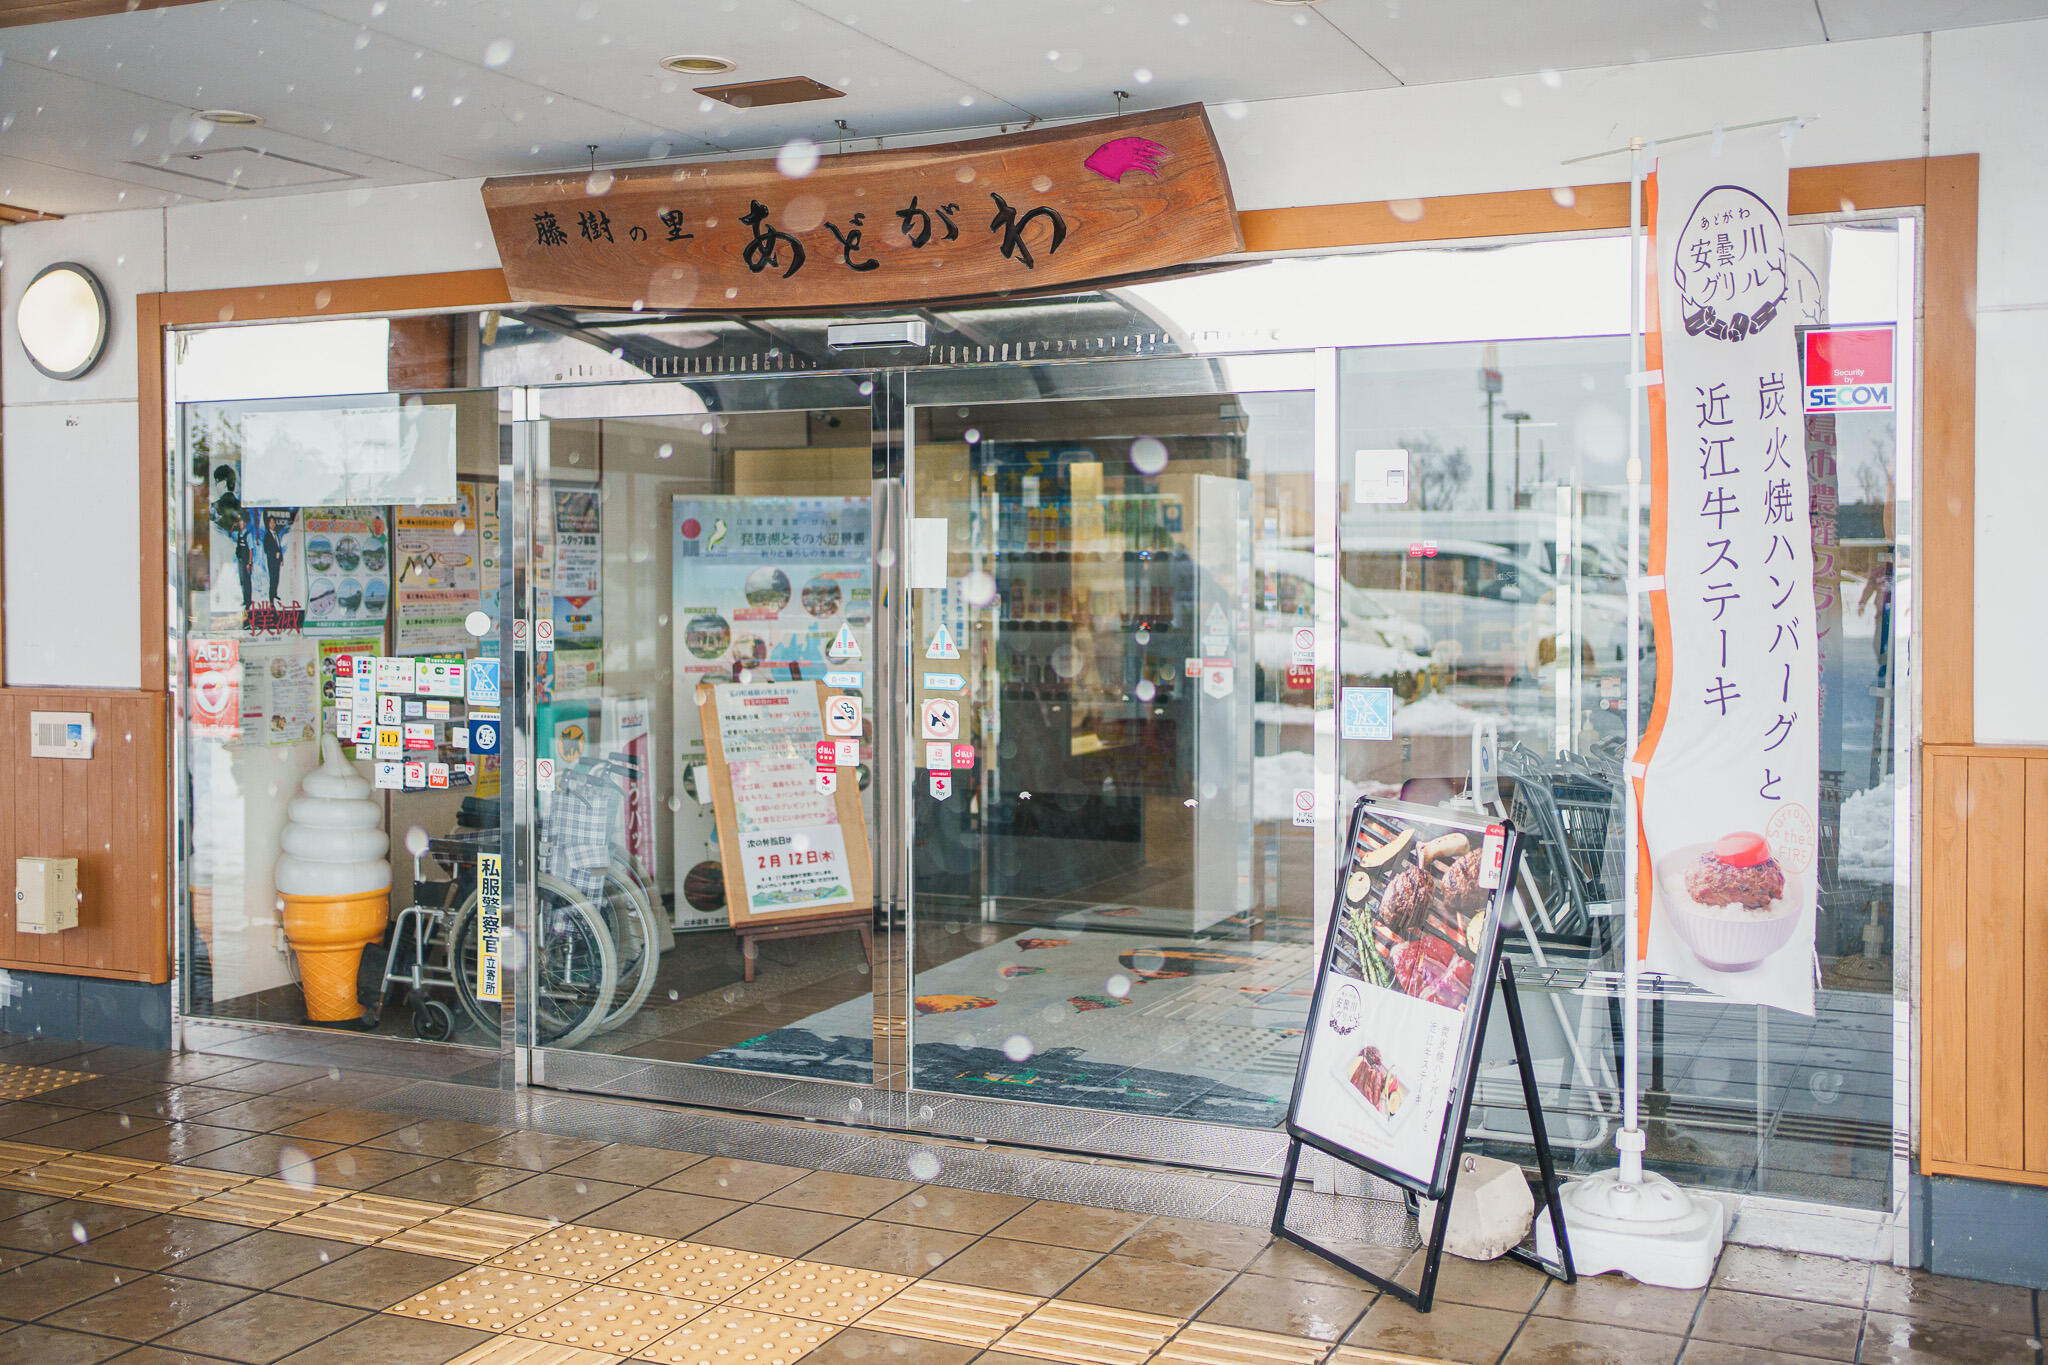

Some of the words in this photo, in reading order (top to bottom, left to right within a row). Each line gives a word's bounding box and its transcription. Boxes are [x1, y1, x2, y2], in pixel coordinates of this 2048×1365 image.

[1700, 207, 1751, 231] あどがわ
[533, 209, 695, 246] 藤樹の里
[742, 190, 1068, 279] あどがわ
[1690, 223, 1768, 273] 安曇川
[1703, 267, 1770, 304] グリル
[1833, 368, 1865, 378] Security
[1844, 375, 1855, 385] by
[1809, 386, 1889, 407] SECOM
[1695, 381, 1742, 717] 近江牛ステーキ
[1758, 372, 1800, 801] 炭火焼ハンバーグと
[248, 600, 302, 637] 撲滅
[195, 644, 230, 662] AED
[383, 714, 396, 723] Edy
[936, 789, 946, 797] Pay
[1779, 846, 1808, 865] FIRE
